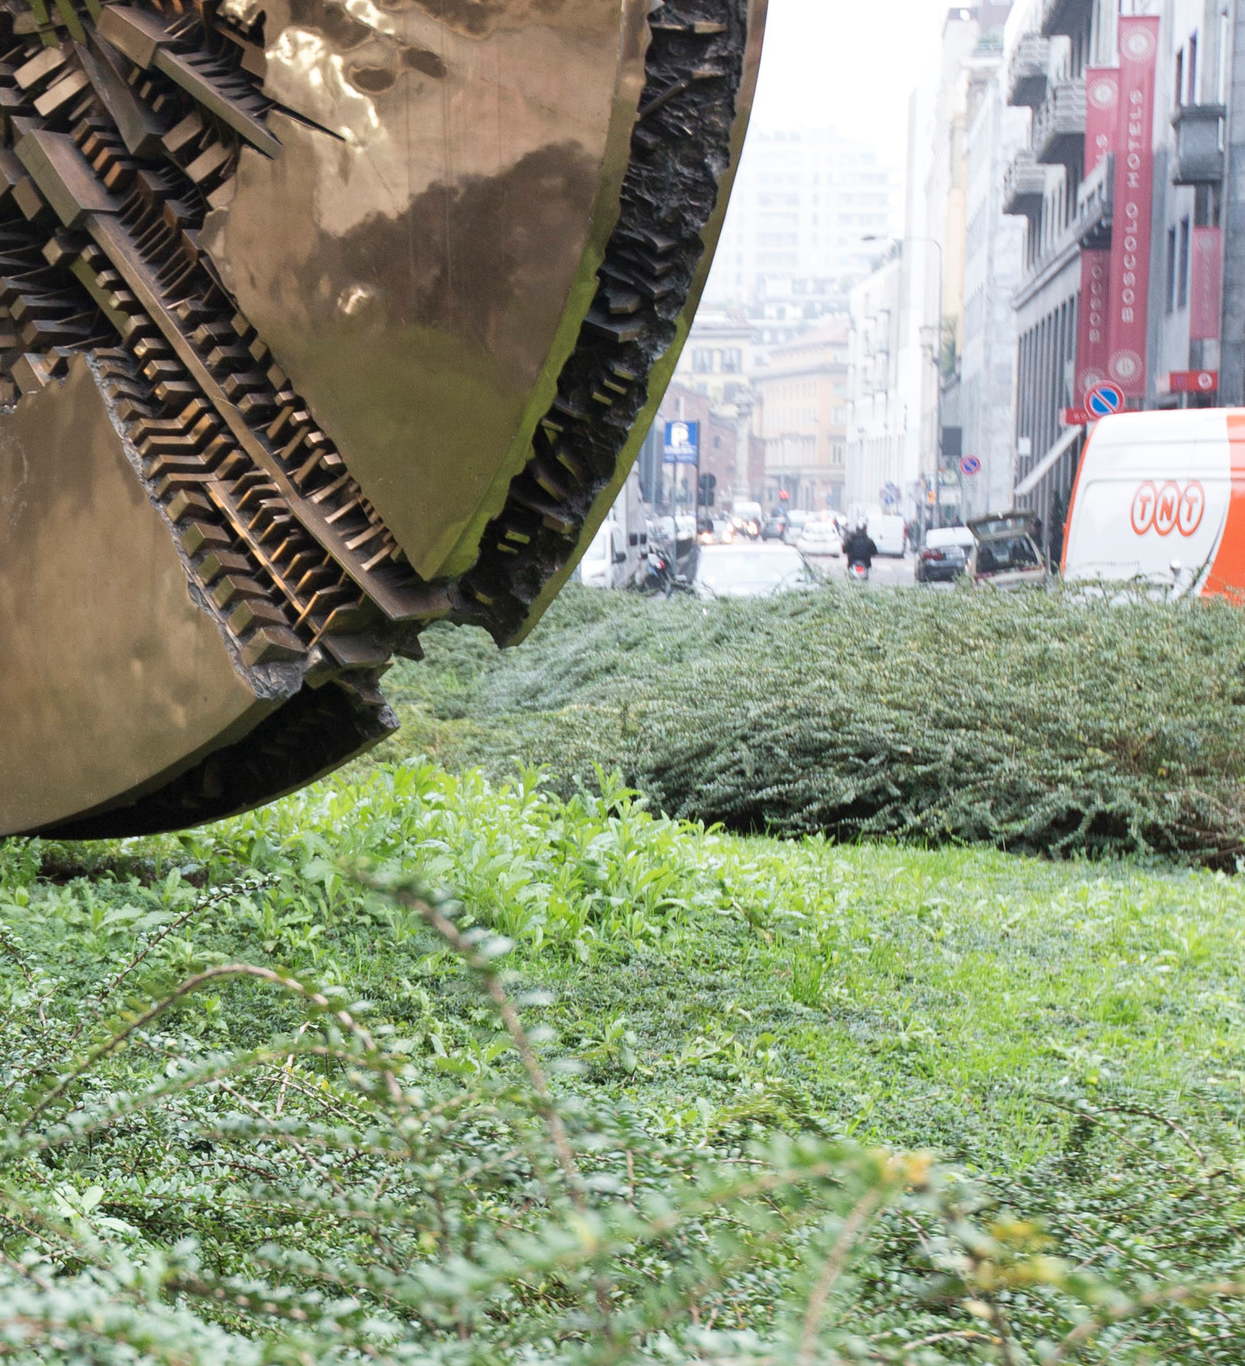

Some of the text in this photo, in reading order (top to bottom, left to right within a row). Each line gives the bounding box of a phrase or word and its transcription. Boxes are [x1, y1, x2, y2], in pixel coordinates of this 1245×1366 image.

[1121, 89, 1143, 323] BOSCOLO HOTELS
[1089, 250, 1103, 343] BOSCOL
